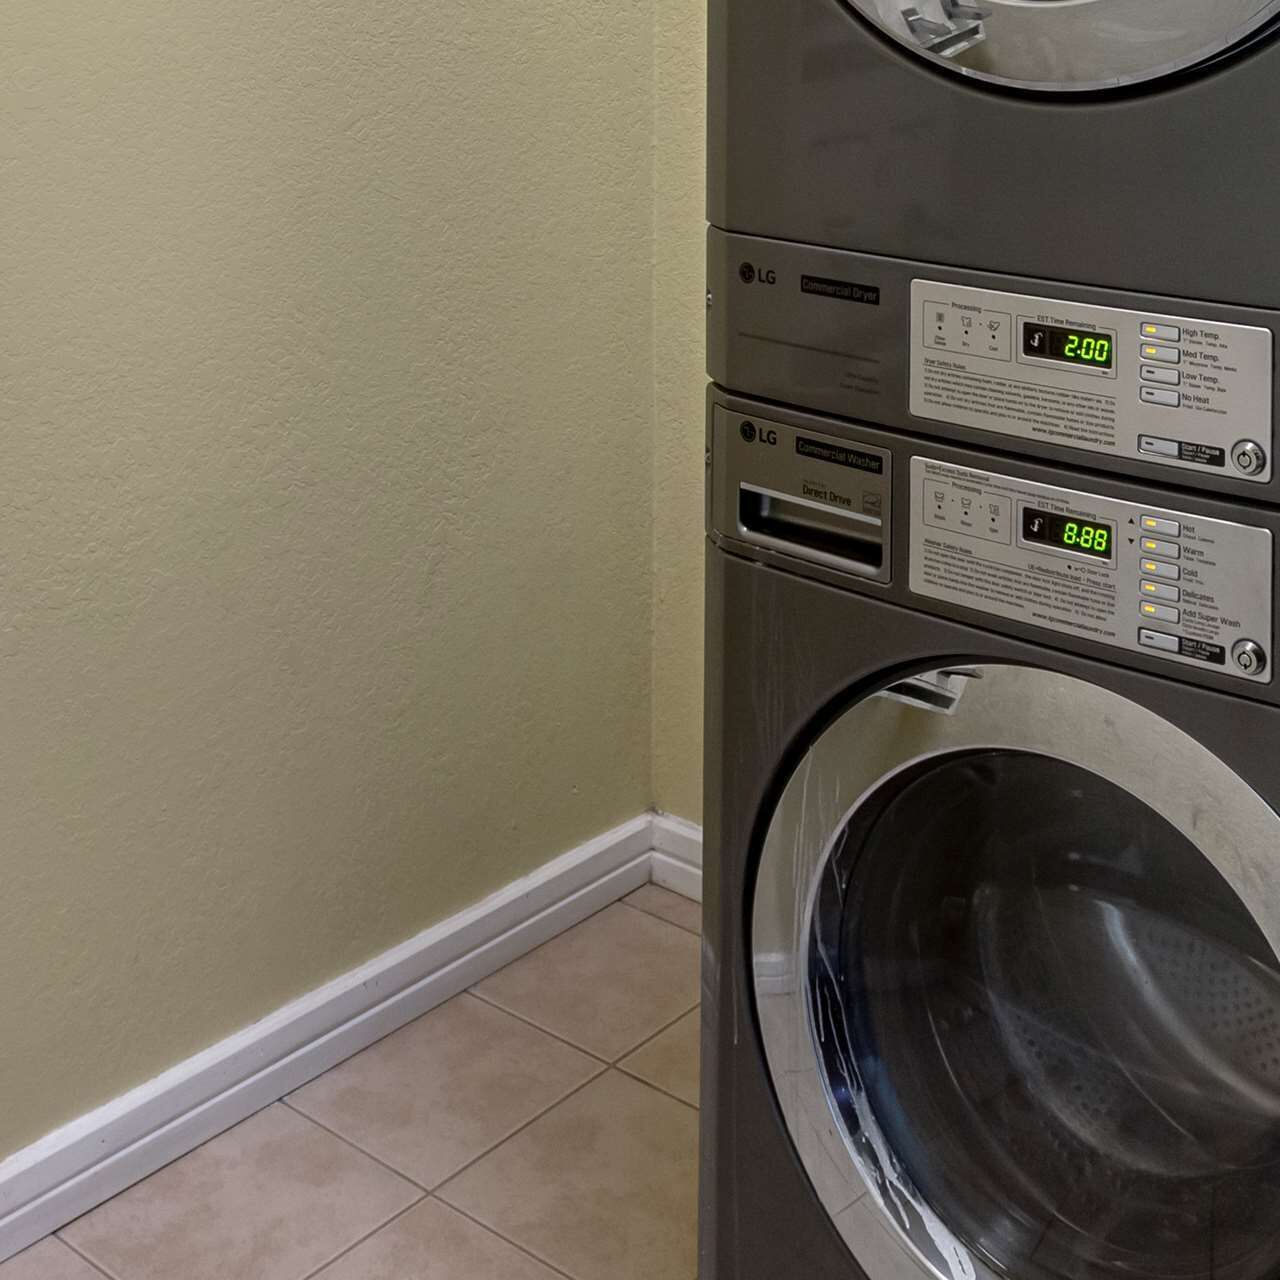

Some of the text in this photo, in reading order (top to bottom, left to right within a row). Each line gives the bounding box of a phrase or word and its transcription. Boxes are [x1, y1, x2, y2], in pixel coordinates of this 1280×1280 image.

[758, 268, 776, 284] LG
[802, 278, 878, 302] Commercial Dryer
[951, 302, 982, 314] Processing
[1182, 328, 1221, 341] High Temp.
[1182, 350, 1219, 362] Med Temp.
[1182, 371, 1219, 384] Low Temp.
[1182, 393, 1210, 405] No Heat
[759, 428, 777, 446] LG
[798, 440, 881, 470] Commercial Washer
[802, 483, 827, 500] Direct
[829, 490, 852, 506] Drive
[951, 482, 982, 495] Processing
[1183, 524, 1195, 534] Hot
[1183, 546, 1205, 557] Warm
[1182, 568, 1198, 578] Cold
[1182, 590, 1215, 603] Delicates
[1182, 609, 1197, 618] Add
[1197, 612, 1217, 623] Super
[1220, 618, 1241, 629] Wash
